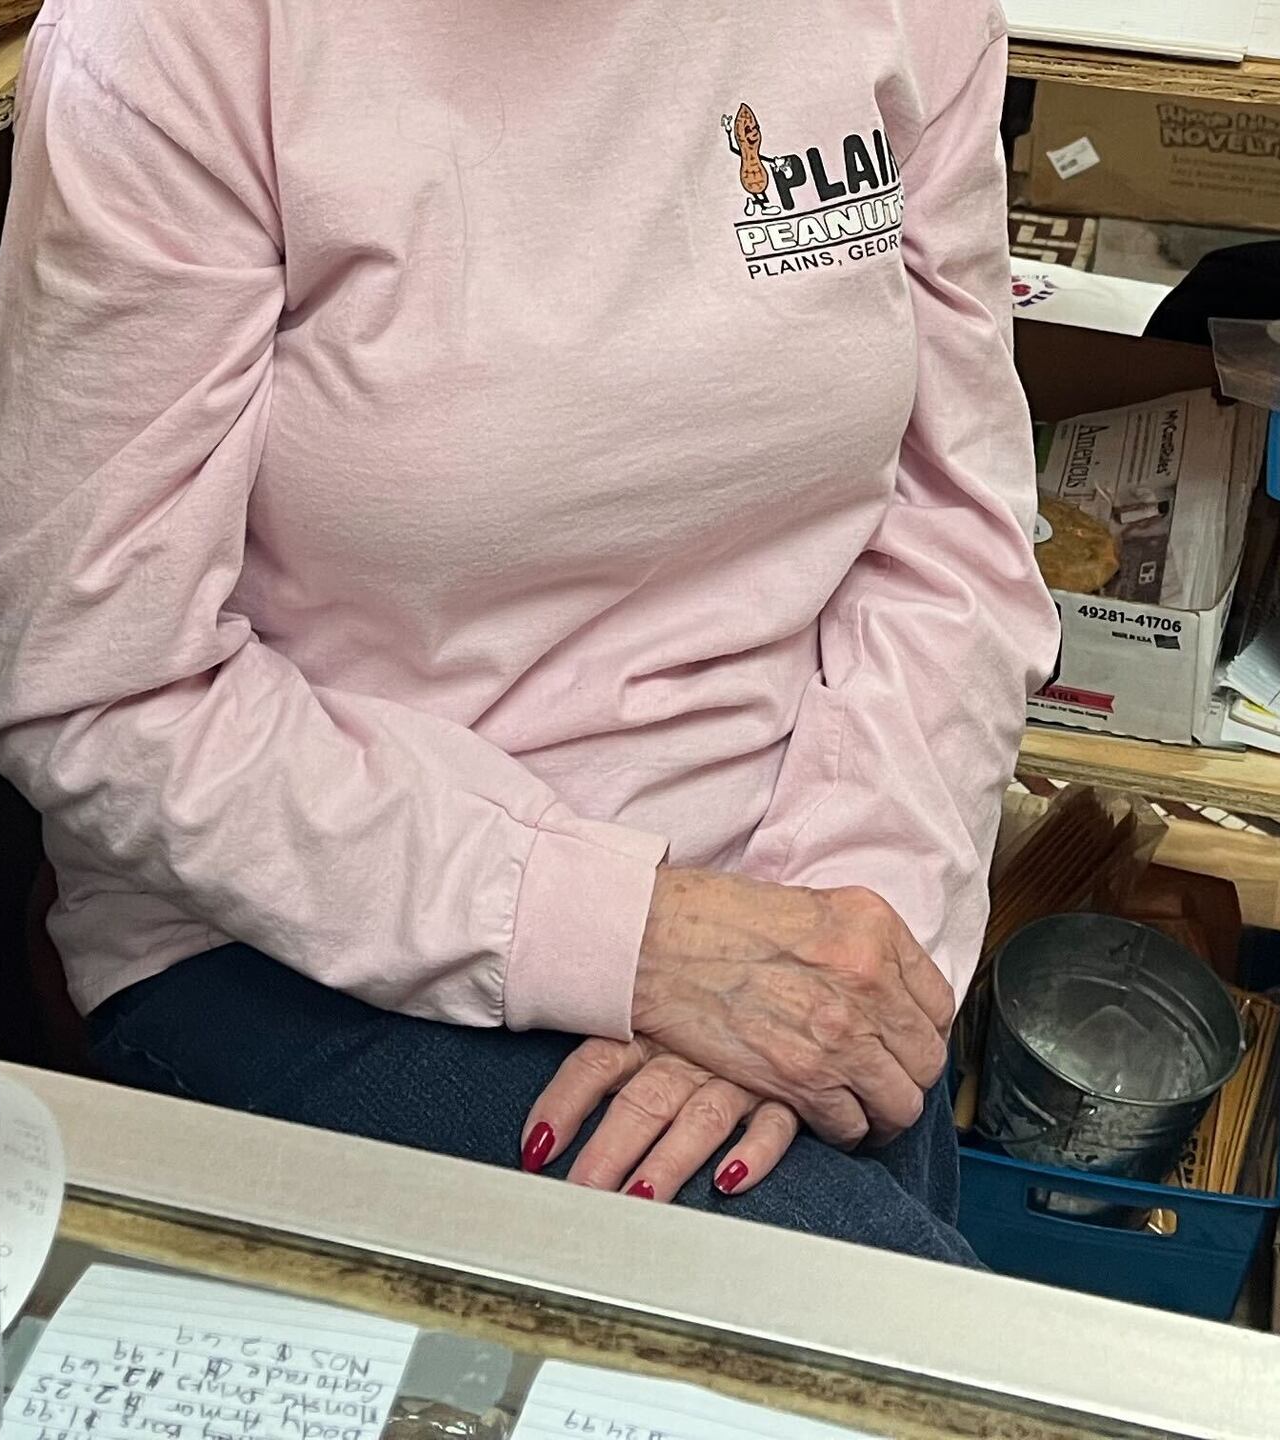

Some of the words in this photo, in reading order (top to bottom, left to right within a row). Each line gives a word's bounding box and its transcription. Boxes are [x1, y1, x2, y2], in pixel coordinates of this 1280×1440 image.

[747, 250, 844, 280] PLAINS,
[847, 230, 903, 262] GEOR
[1064, 423, 1110, 490] Americus
[1077, 604, 1183, 634] 49281-41706
[311, 1347, 371, 1377] NOS
[247, 1361, 384, 1402] Gatorade
[166, 1400, 262, 1430] Armor
[278, 1391, 379, 1426] Monster
